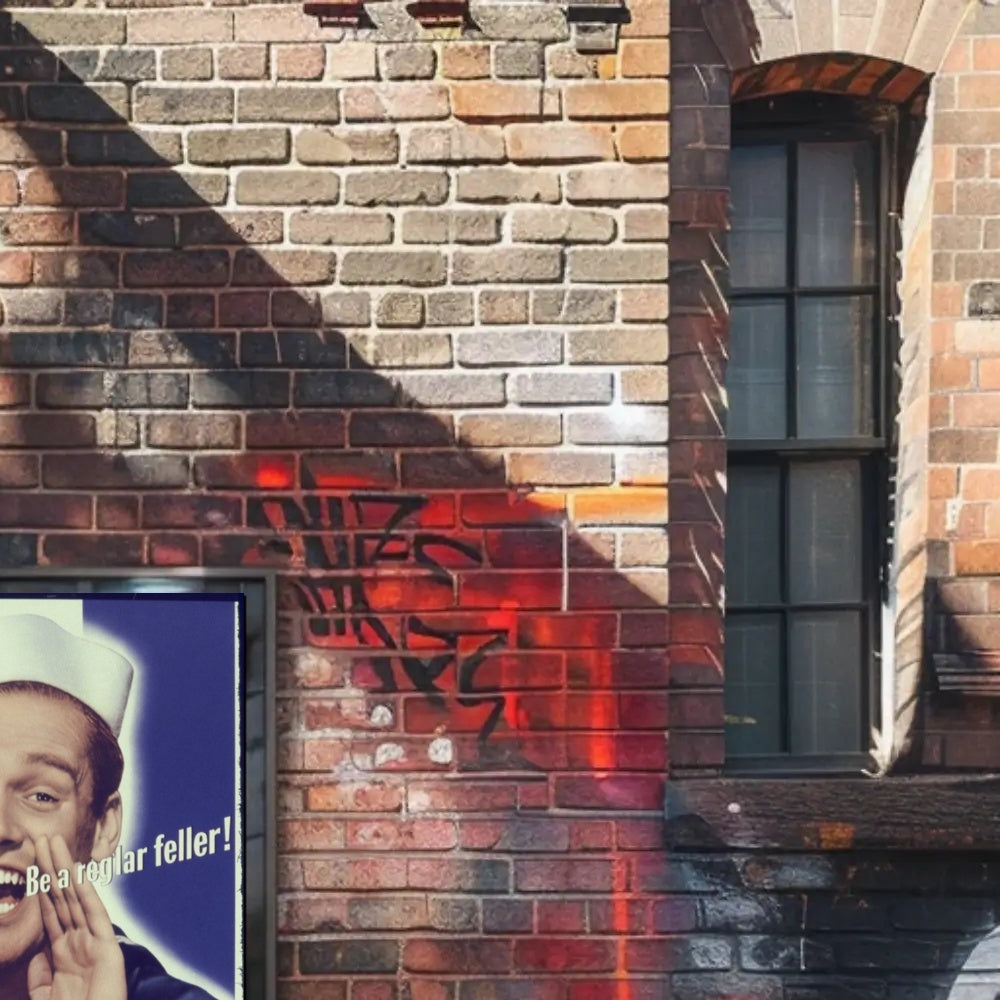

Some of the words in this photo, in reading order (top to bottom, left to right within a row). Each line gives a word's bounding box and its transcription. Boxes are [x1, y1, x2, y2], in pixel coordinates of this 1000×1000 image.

[26, 864, 51, 897] Be
[57, 868, 70, 889] a
[153, 815, 232, 868] feller!
